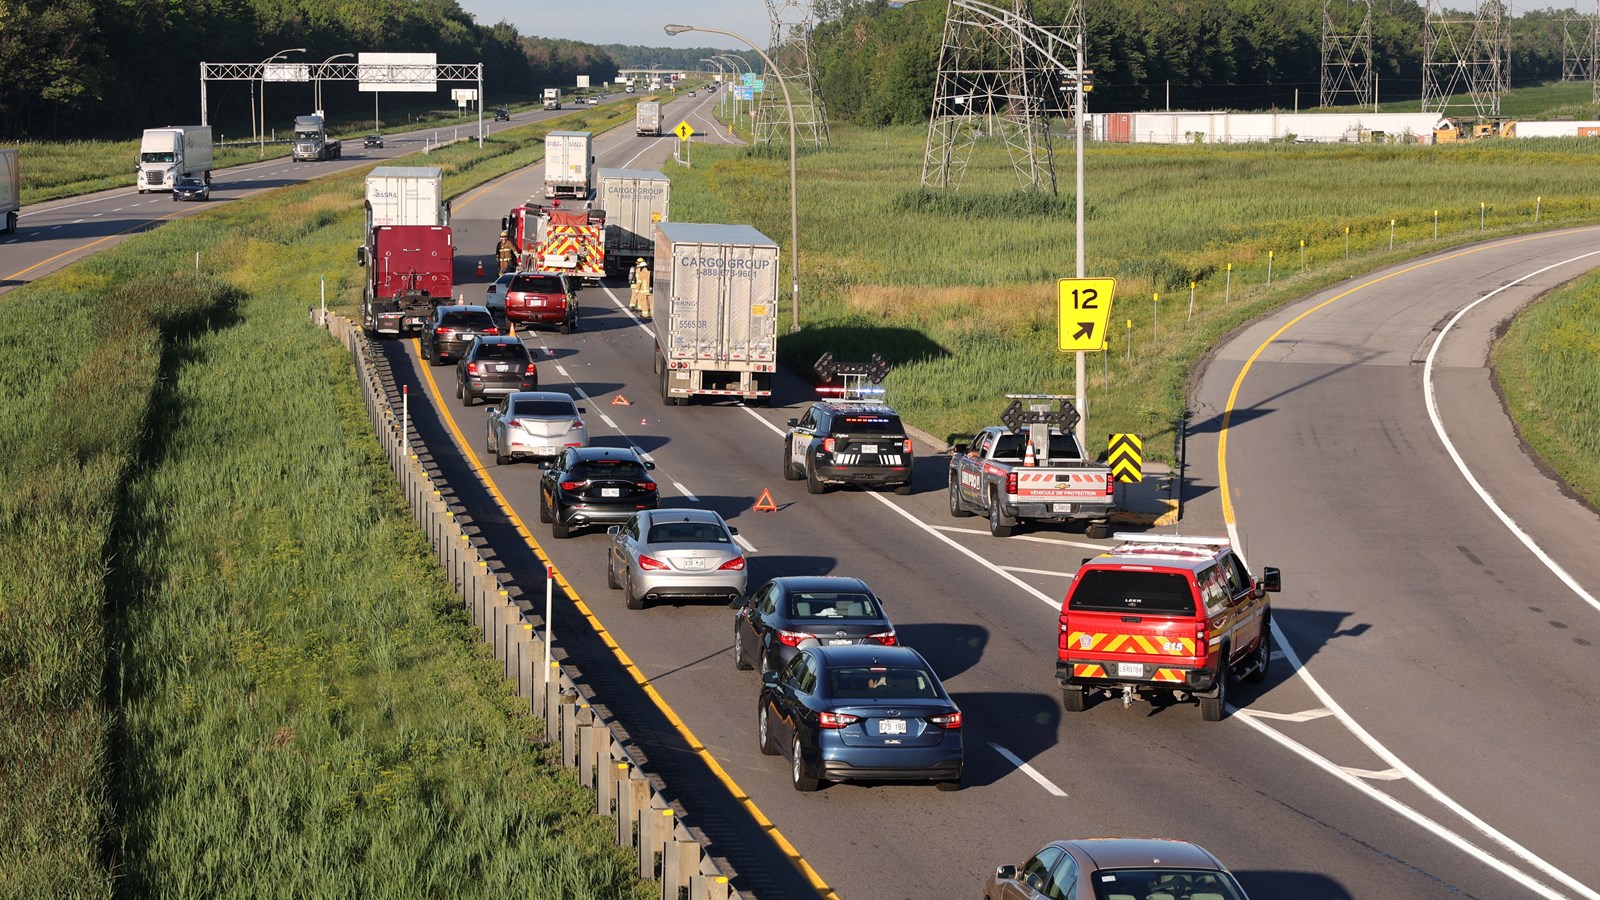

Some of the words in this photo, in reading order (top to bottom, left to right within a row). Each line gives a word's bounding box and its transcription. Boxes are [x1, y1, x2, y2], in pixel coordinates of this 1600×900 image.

[608, 186, 634, 194] CARGO
[638, 187, 664, 195] GROUP
[681, 256, 724, 268] CARGO
[728, 258, 770, 270] GROUP
[1071, 288, 1098, 310] 12
[1163, 641, 1183, 651] 815
